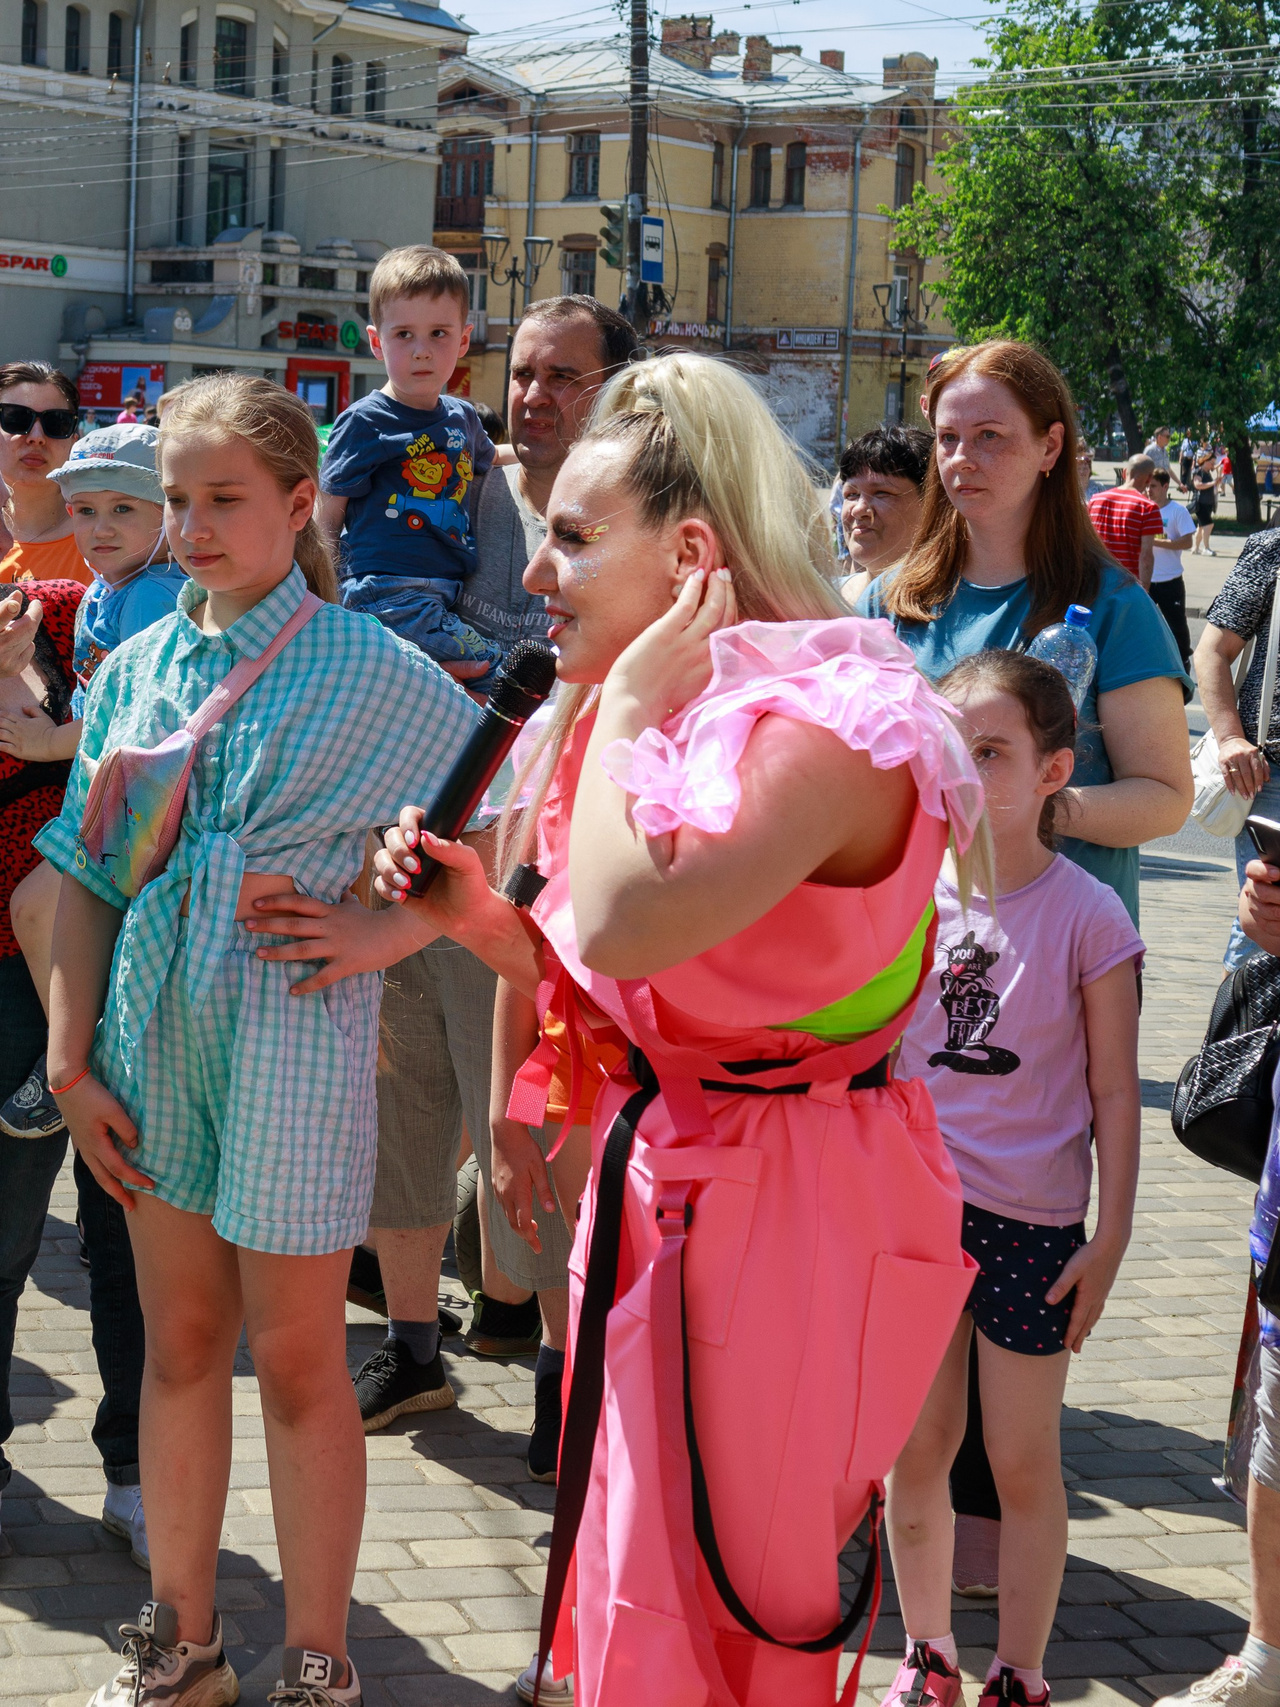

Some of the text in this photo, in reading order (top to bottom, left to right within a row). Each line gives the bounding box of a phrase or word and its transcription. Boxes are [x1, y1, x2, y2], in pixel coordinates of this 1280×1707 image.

[278, 321, 338, 342] SPAR
[685, 323, 710, 338] НОЧЬ
[83, 366, 120, 374] ОДКЛЮЧИ
[406, 433, 431, 457] Drive
[476, 601, 512, 628] JEANS
[951, 948, 975, 961] YOU
[967, 963, 982, 971] ARE
[951, 996, 999, 1018] BEST
